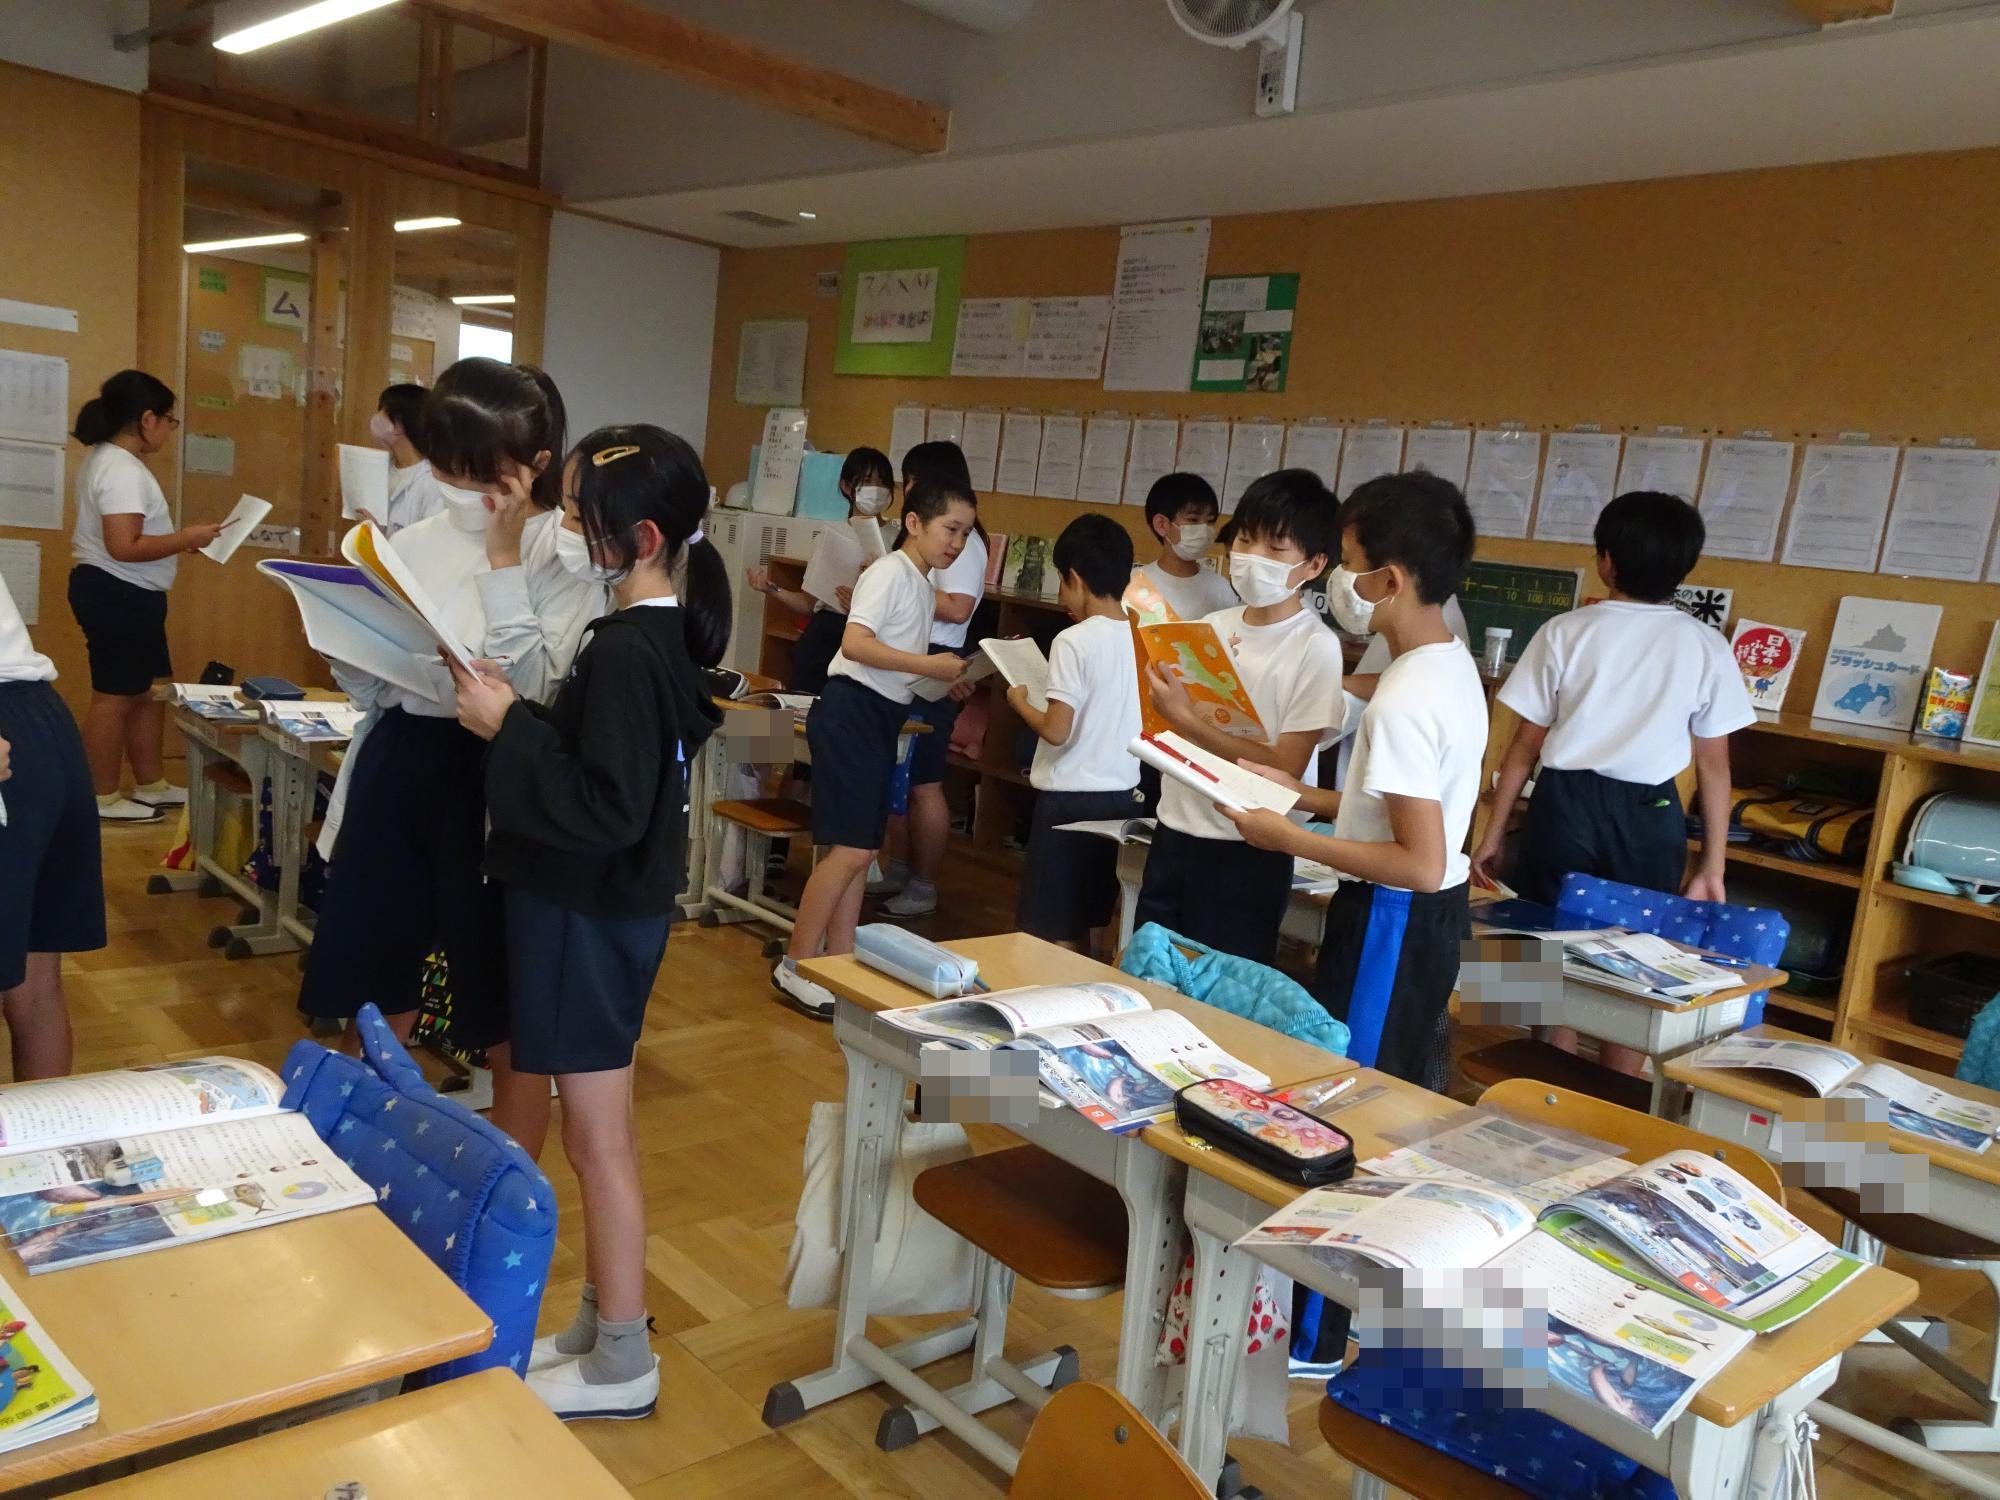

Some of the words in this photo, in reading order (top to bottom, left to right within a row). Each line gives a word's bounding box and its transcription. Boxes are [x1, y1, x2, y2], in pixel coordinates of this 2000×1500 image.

[1761, 633, 1785, 666] 日本の
[1829, 654, 1921, 676] フラッシュカード
